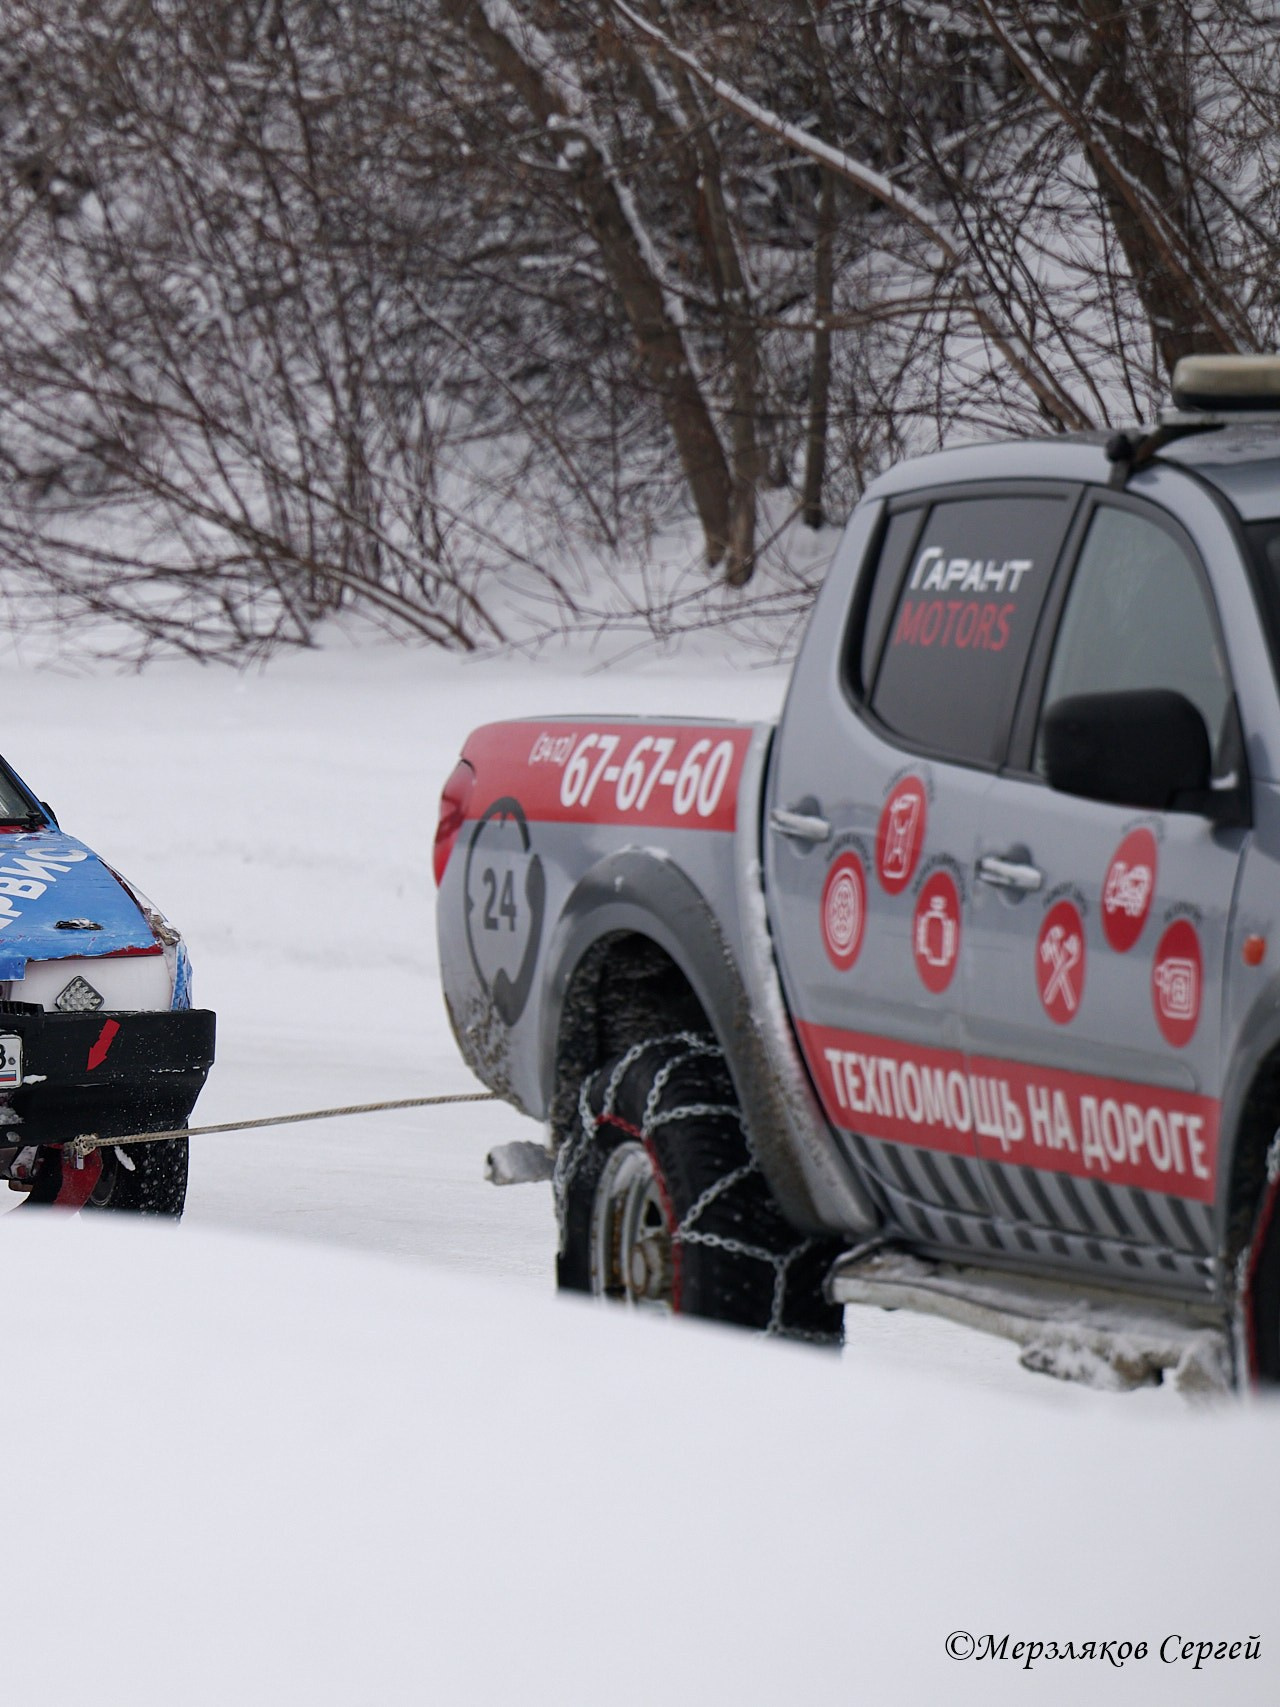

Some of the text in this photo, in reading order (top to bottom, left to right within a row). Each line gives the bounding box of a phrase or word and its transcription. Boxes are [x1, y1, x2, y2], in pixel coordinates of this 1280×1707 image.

[895, 600, 1016, 651] MOTORS
[560, 733, 734, 817] 67-67-60
[482, 867, 517, 932] 24
[824, 1047, 1211, 1180] ТЕХПОМОЩЬ НА ДОРОГЕ
